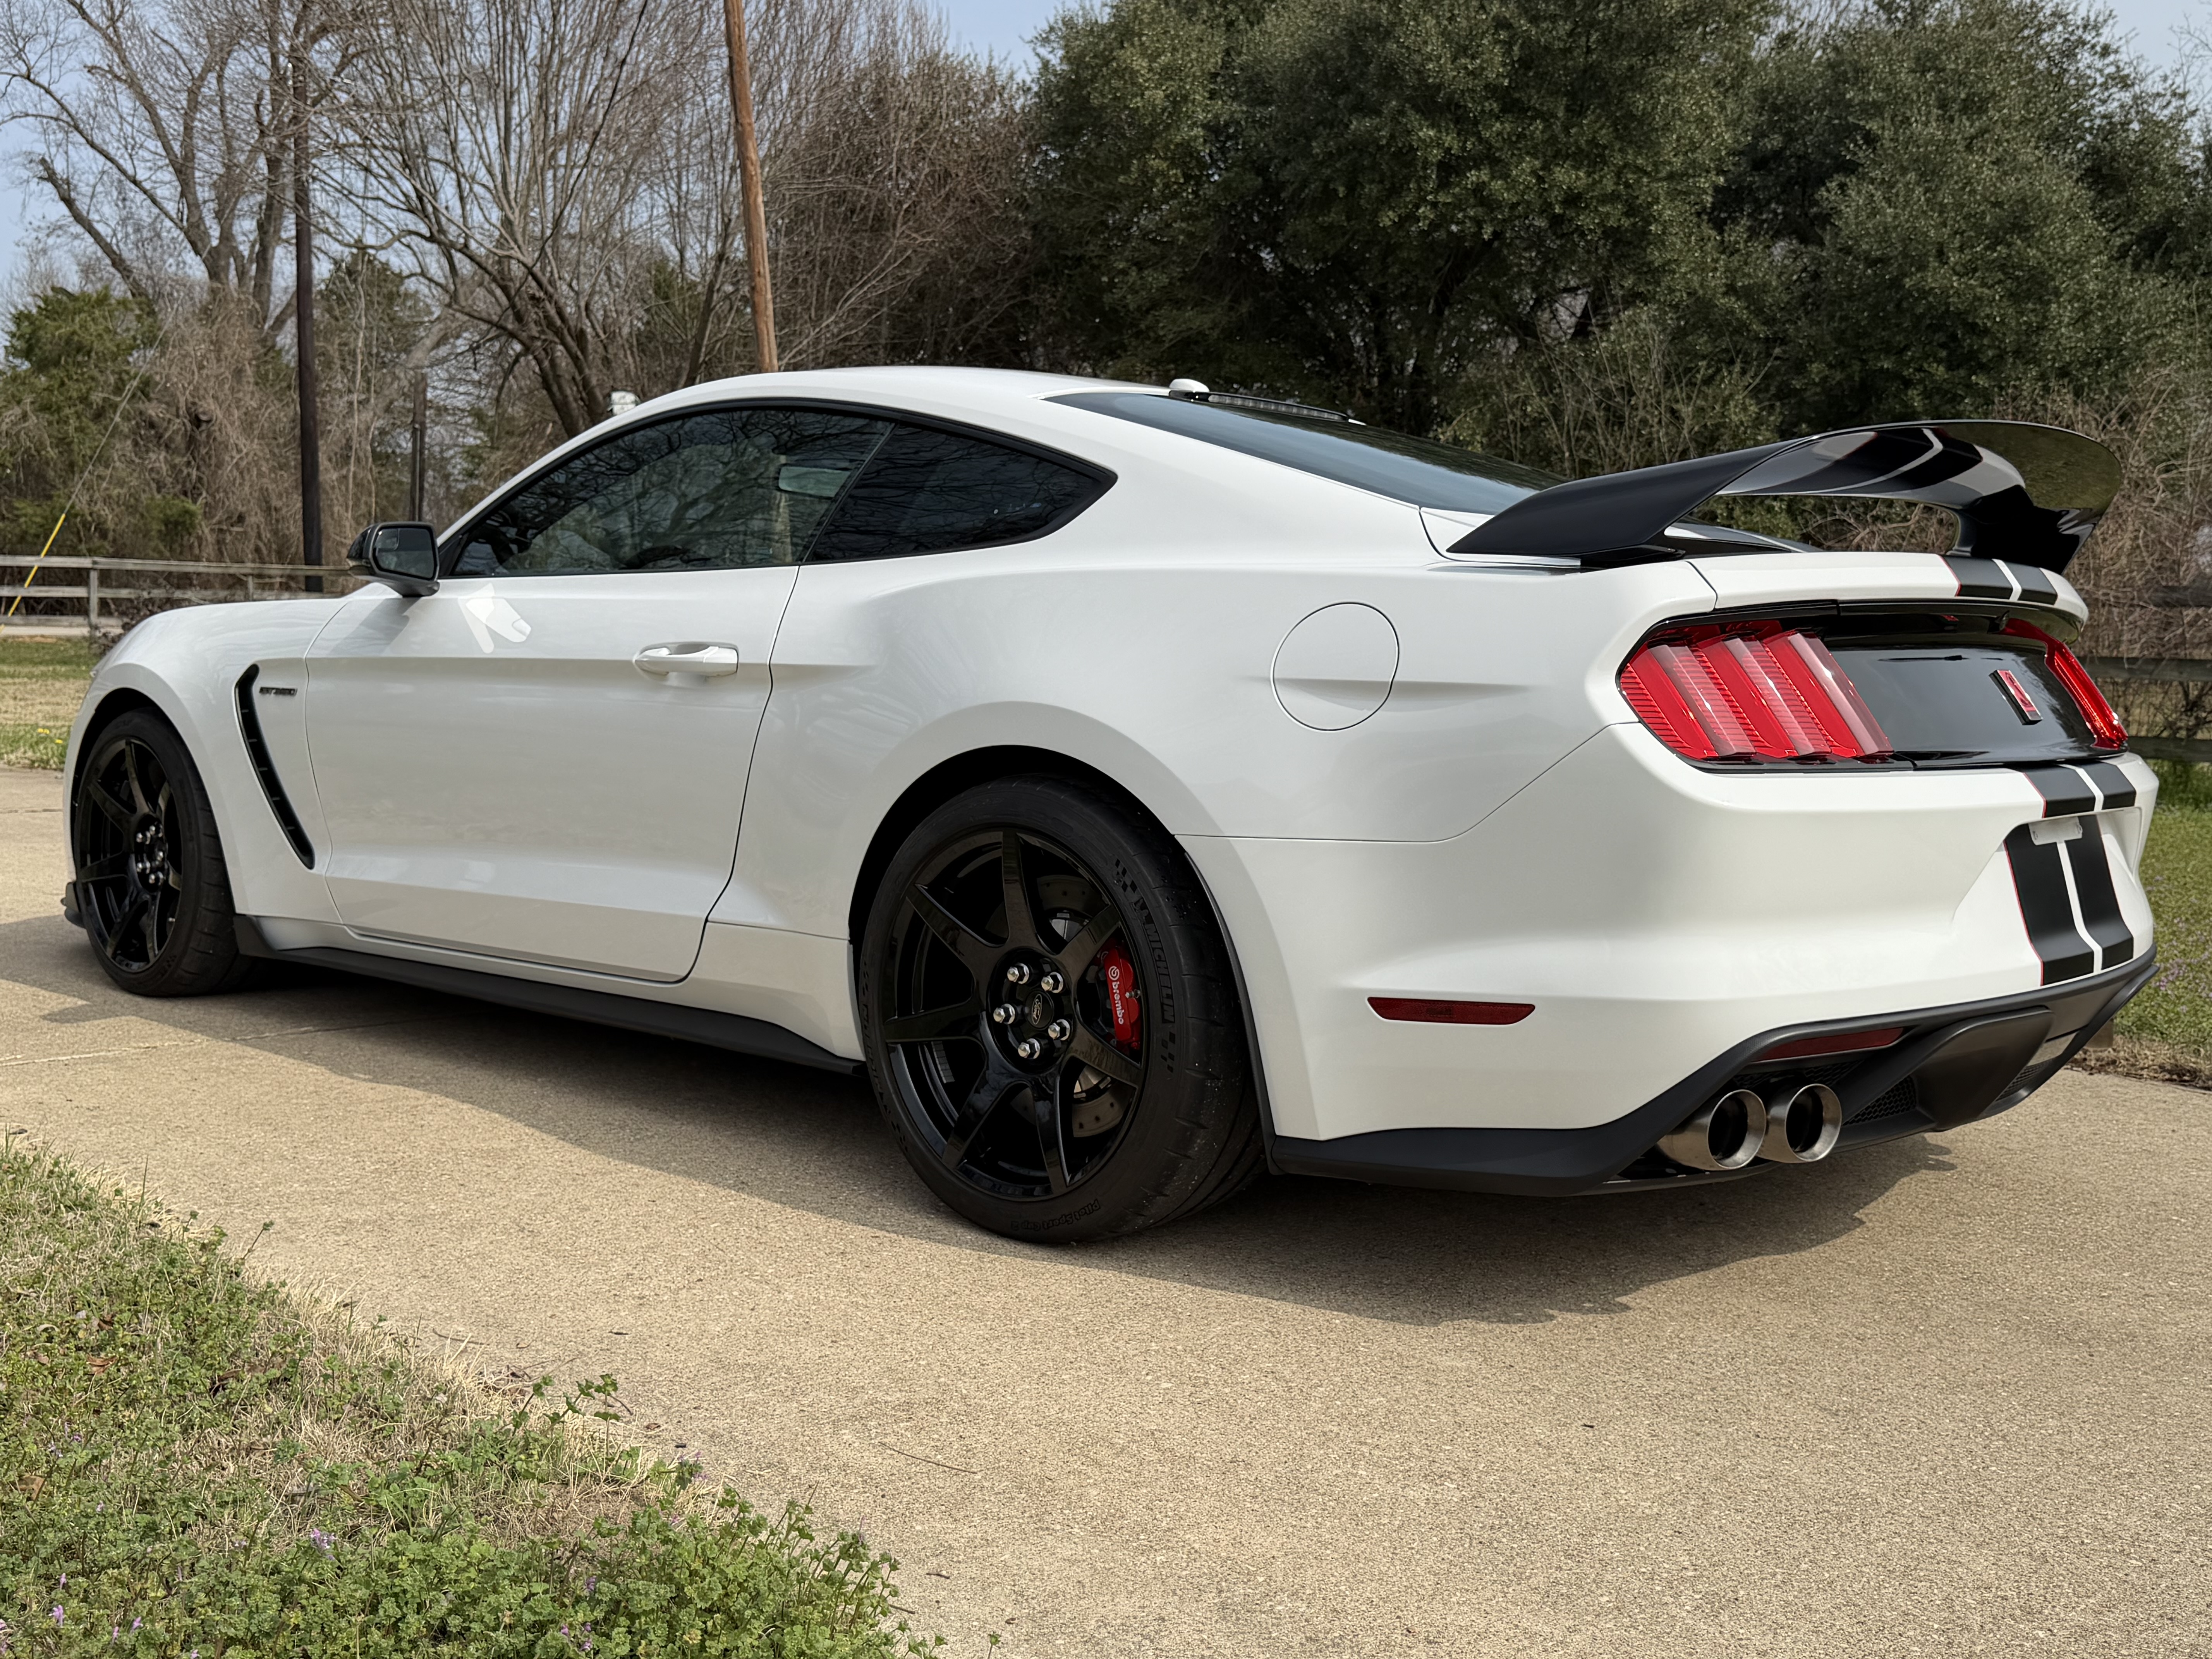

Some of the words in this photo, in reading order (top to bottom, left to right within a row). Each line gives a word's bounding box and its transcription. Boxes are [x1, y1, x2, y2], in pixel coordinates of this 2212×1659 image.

[1143, 923, 1175, 1023] MICHELIN
[1112, 981, 1124, 1024] brembo
[1074, 1199, 1101, 1220] Pilot
[1010, 1221, 1020, 1231] 2
[1021, 1220, 1041, 1231] Cup
[1042, 1212, 1073, 1230] Sport
